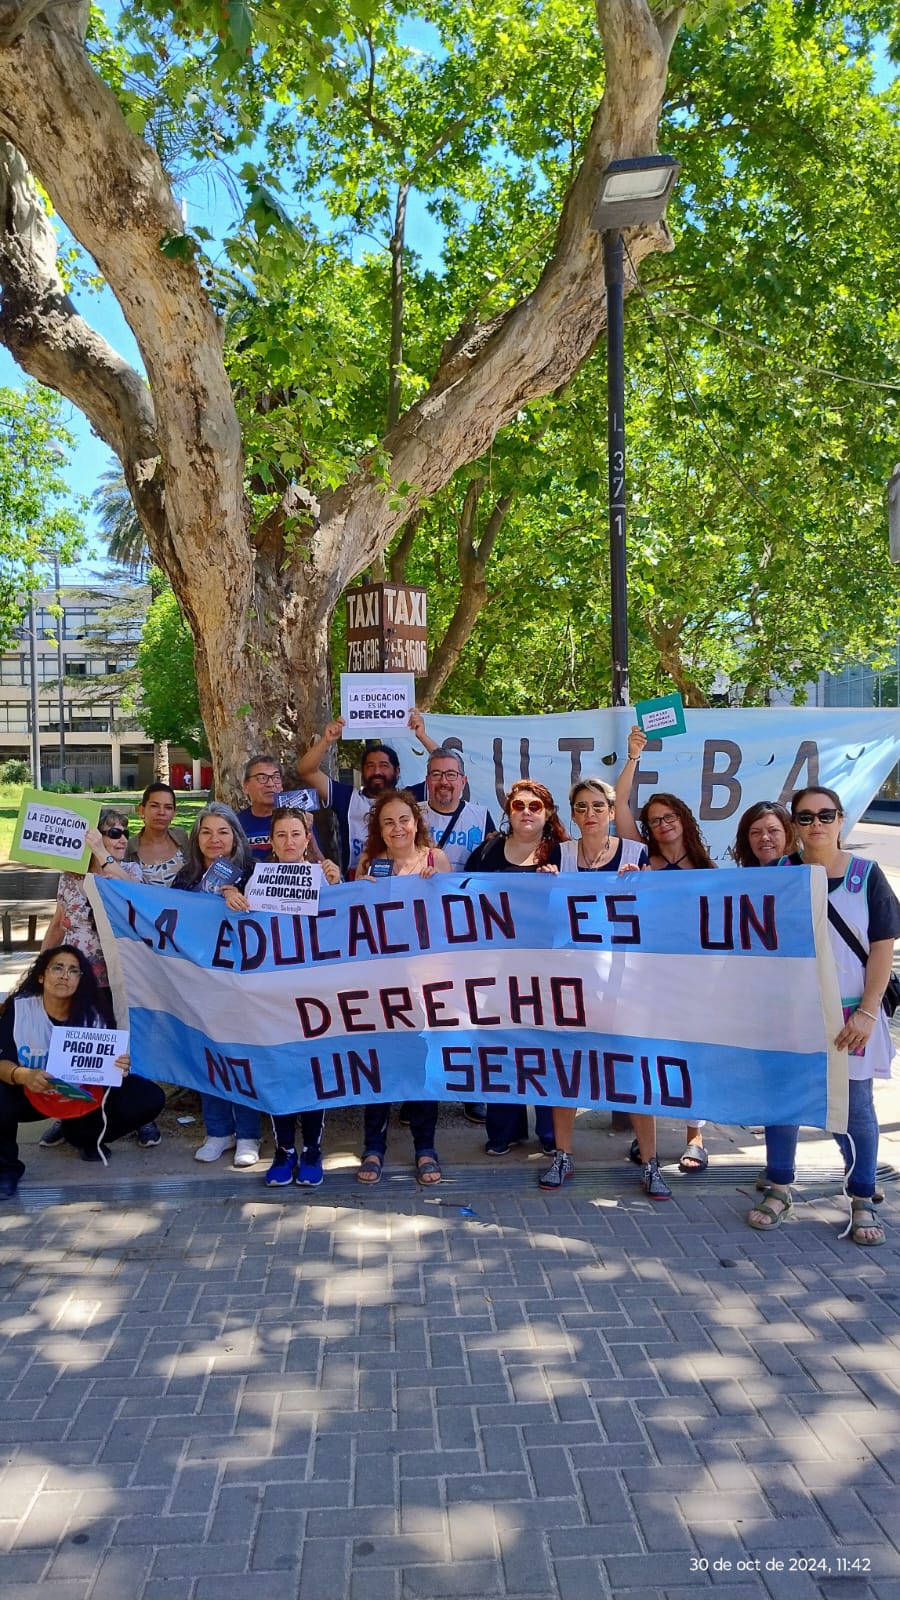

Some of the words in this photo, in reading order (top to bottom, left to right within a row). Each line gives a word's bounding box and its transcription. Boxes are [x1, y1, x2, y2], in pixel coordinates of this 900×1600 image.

[347, 591, 380, 629] TAXI
[384, 588, 427, 627] TAXI
[350, 709, 405, 719] DERECHO
[27, 811, 37, 822] LA
[40, 813, 87, 830] EDUCACIÓN
[45, 825, 54, 833] ES
[55, 826, 65, 834] UN
[23, 829, 82, 850] DERECHO
[249, 836, 271, 845] Lev
[277, 864, 312, 875] FONDOS
[257, 874, 312, 887] NACIONALES
[249, 887, 265, 896] PARA
[266, 886, 318, 900] EDUCACIÓN
[126, 900, 180, 953] LA
[211, 877, 516, 971] EDUCACIÓN
[567, 894, 641, 945] ES
[699, 894, 779, 951] UN
[295, 976, 587, 1039] DERECHO
[65, 1030, 110, 1042] RECLAMAMOS
[111, 1034, 117, 1042] EL
[63, 1040, 94, 1054] PAGO
[96, 1044, 116, 1056] DEL
[71, 1055, 104, 1069] FONID
[204, 1047, 258, 1100] NO
[310, 1048, 382, 1101] UN
[441, 1046, 693, 1109] SERVICIO
